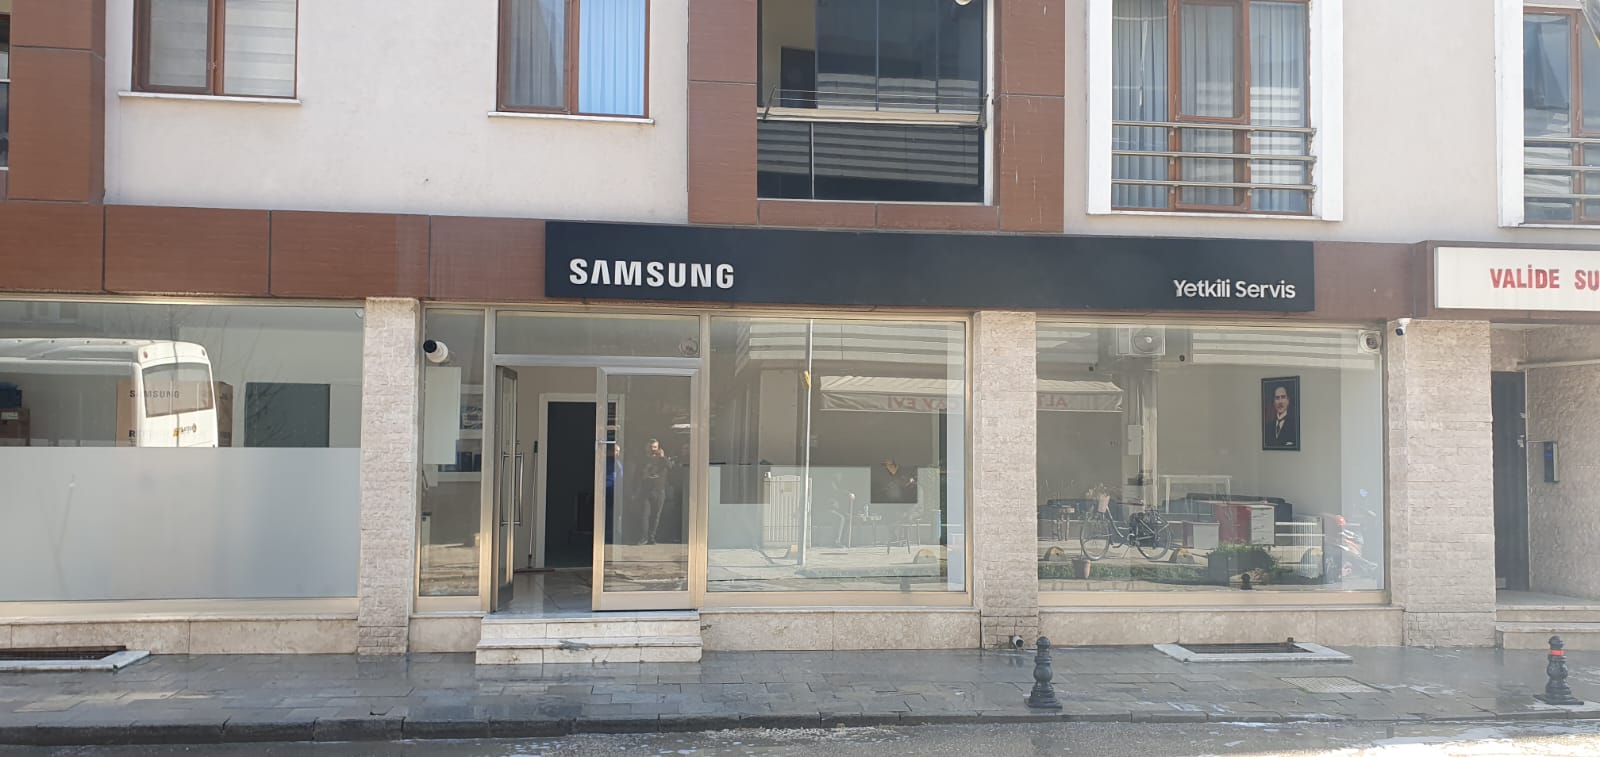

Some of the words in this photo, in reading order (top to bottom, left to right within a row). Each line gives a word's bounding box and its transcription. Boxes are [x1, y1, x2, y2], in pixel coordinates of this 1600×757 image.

[569, 258, 734, 289] SAMSUNG
[1489, 264, 1560, 289] VALİDE
[1173, 278, 1231, 298] Yetkili
[1235, 280, 1296, 299] Servis
[129, 390, 180, 398] SMSUNG
